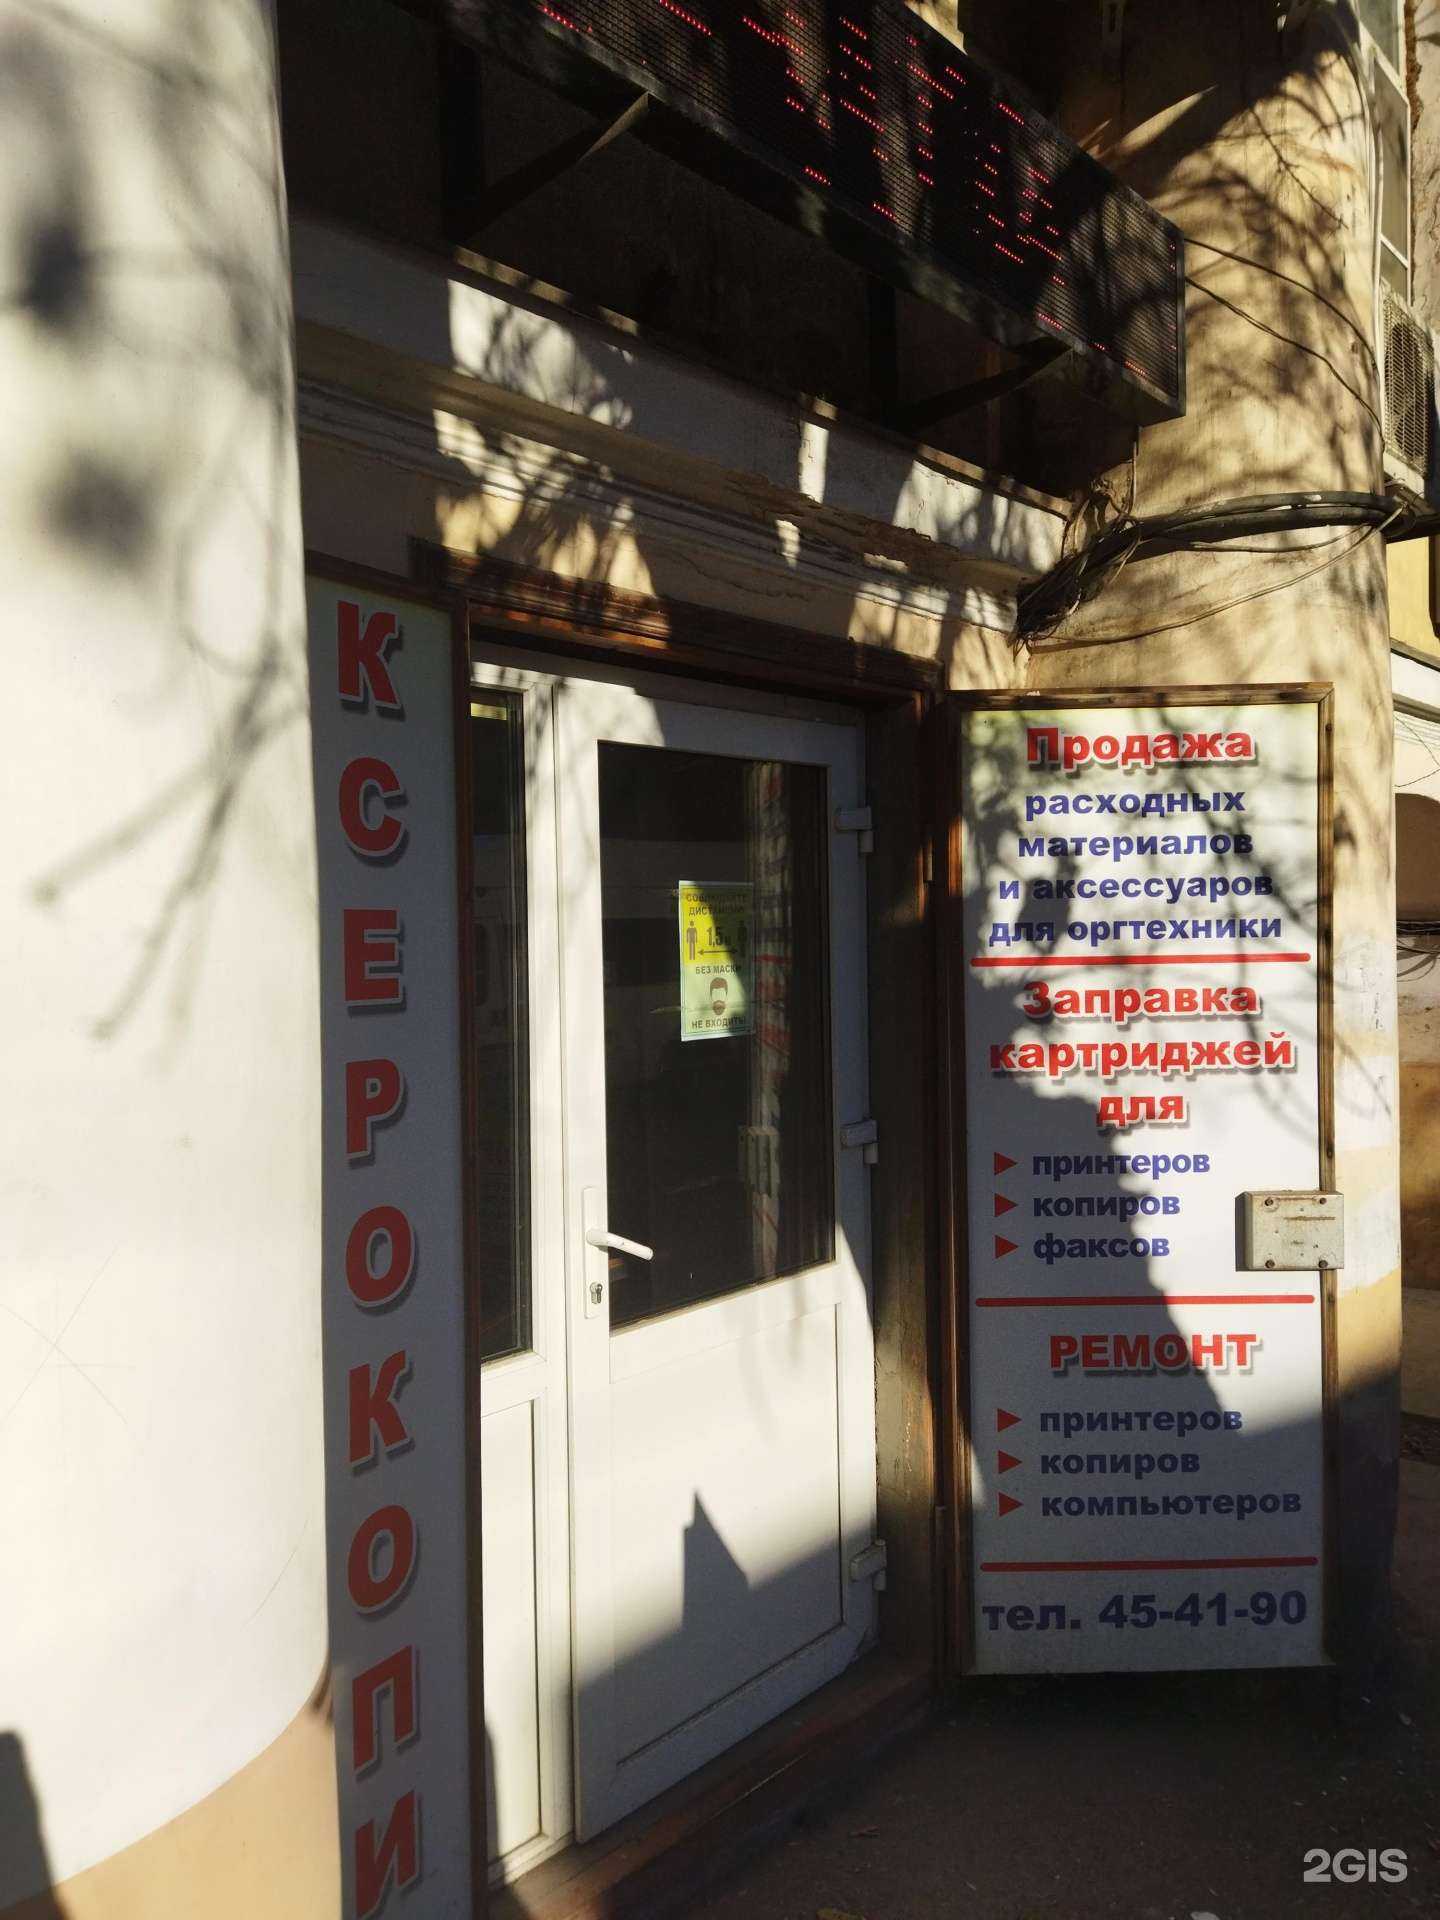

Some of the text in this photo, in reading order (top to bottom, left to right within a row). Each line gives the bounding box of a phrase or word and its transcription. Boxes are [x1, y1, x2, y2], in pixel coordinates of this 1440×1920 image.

[1026, 727, 1255, 769] Продажа
[1025, 791, 1246, 821] расходных
[1018, 834, 1253, 862] материалов
[999, 876, 1274, 904] и аксессуаров
[989, 917, 1281, 947] для оргтехники
[695, 964, 713, 975] БЕЗ
[1022, 981, 1259, 1022] Заправка
[691, 1019, 703, 1029] НЕ
[989, 1032, 1292, 1076] картриджей
[1099, 1094, 1185, 1127] для
[1032, 1150, 1211, 1182] принтеров
[1032, 1193, 1181, 1224] копиров
[337, 600, 416, 1919] КСЕРОКОПИ
[1032, 1234, 1170, 1265] факсов
[1049, 1333, 1258, 1370] РЕМОНТ
[1039, 1407, 1243, 1438] принтеров
[1040, 1449, 1201, 1480] копиров
[1041, 1491, 1302, 1521] компьютеров
[982, 1590, 1308, 1632] тел. 45-41-90
